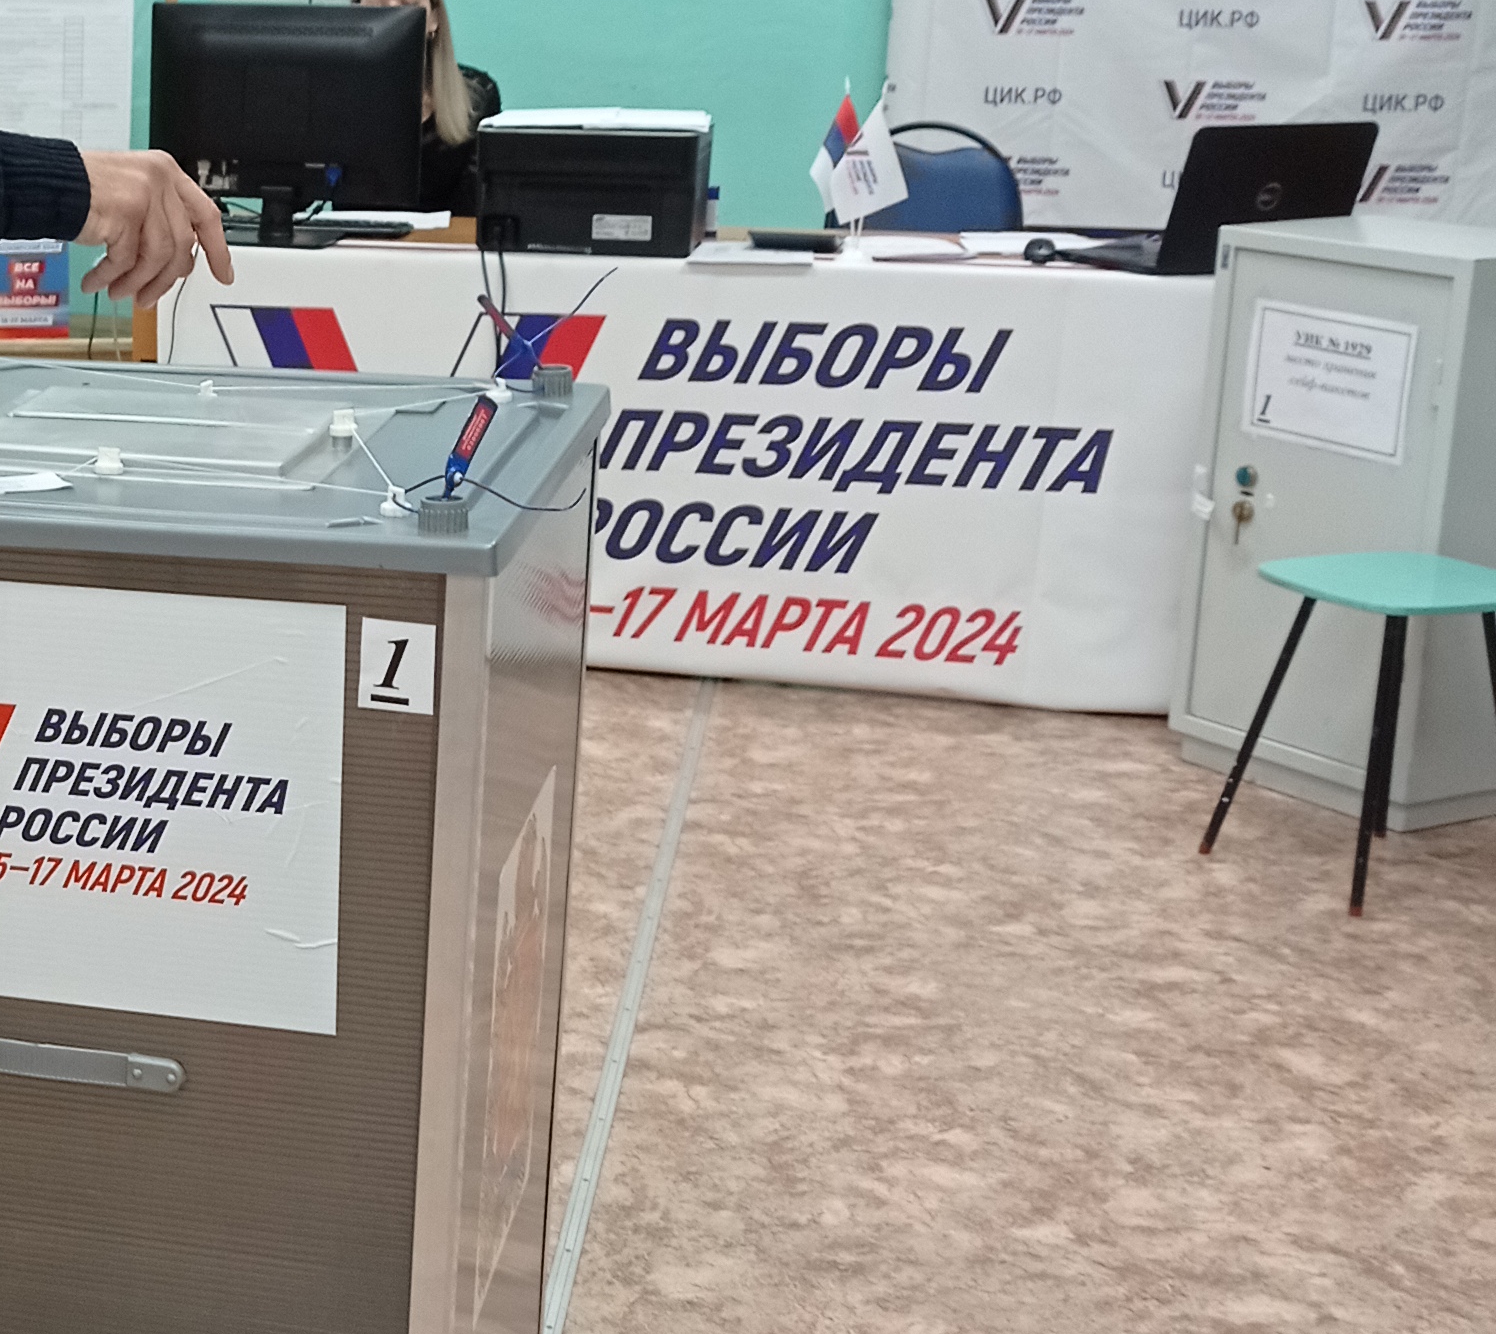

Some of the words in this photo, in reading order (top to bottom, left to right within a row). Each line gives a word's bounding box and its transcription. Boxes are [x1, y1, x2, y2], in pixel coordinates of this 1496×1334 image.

[1178, 9, 1260, 30] ЦИК.РФ
[983, 85, 1063, 107] ЦИК.РФ
[1362, 93, 1445, 115] ЦИК.РФ
[14, 261, 40, 273] ВСЕ
[16, 278, 35, 289] НА
[638, 319, 1014, 394] ВЫБОРЫ
[599, 409, 1114, 494] ПРЕЗИДЕНТА
[674, 589, 871, 656] МАРТА
[875, 603, 1023, 666] 2024
[373, 638, 410, 690] 1
[34, 708, 233, 758] ВЫБОРЫ
[13, 756, 289, 815] ПРЕЗИДЕНТА
[62, 859, 167, 899] МАРТА
[171, 870, 249, 906] 2024
